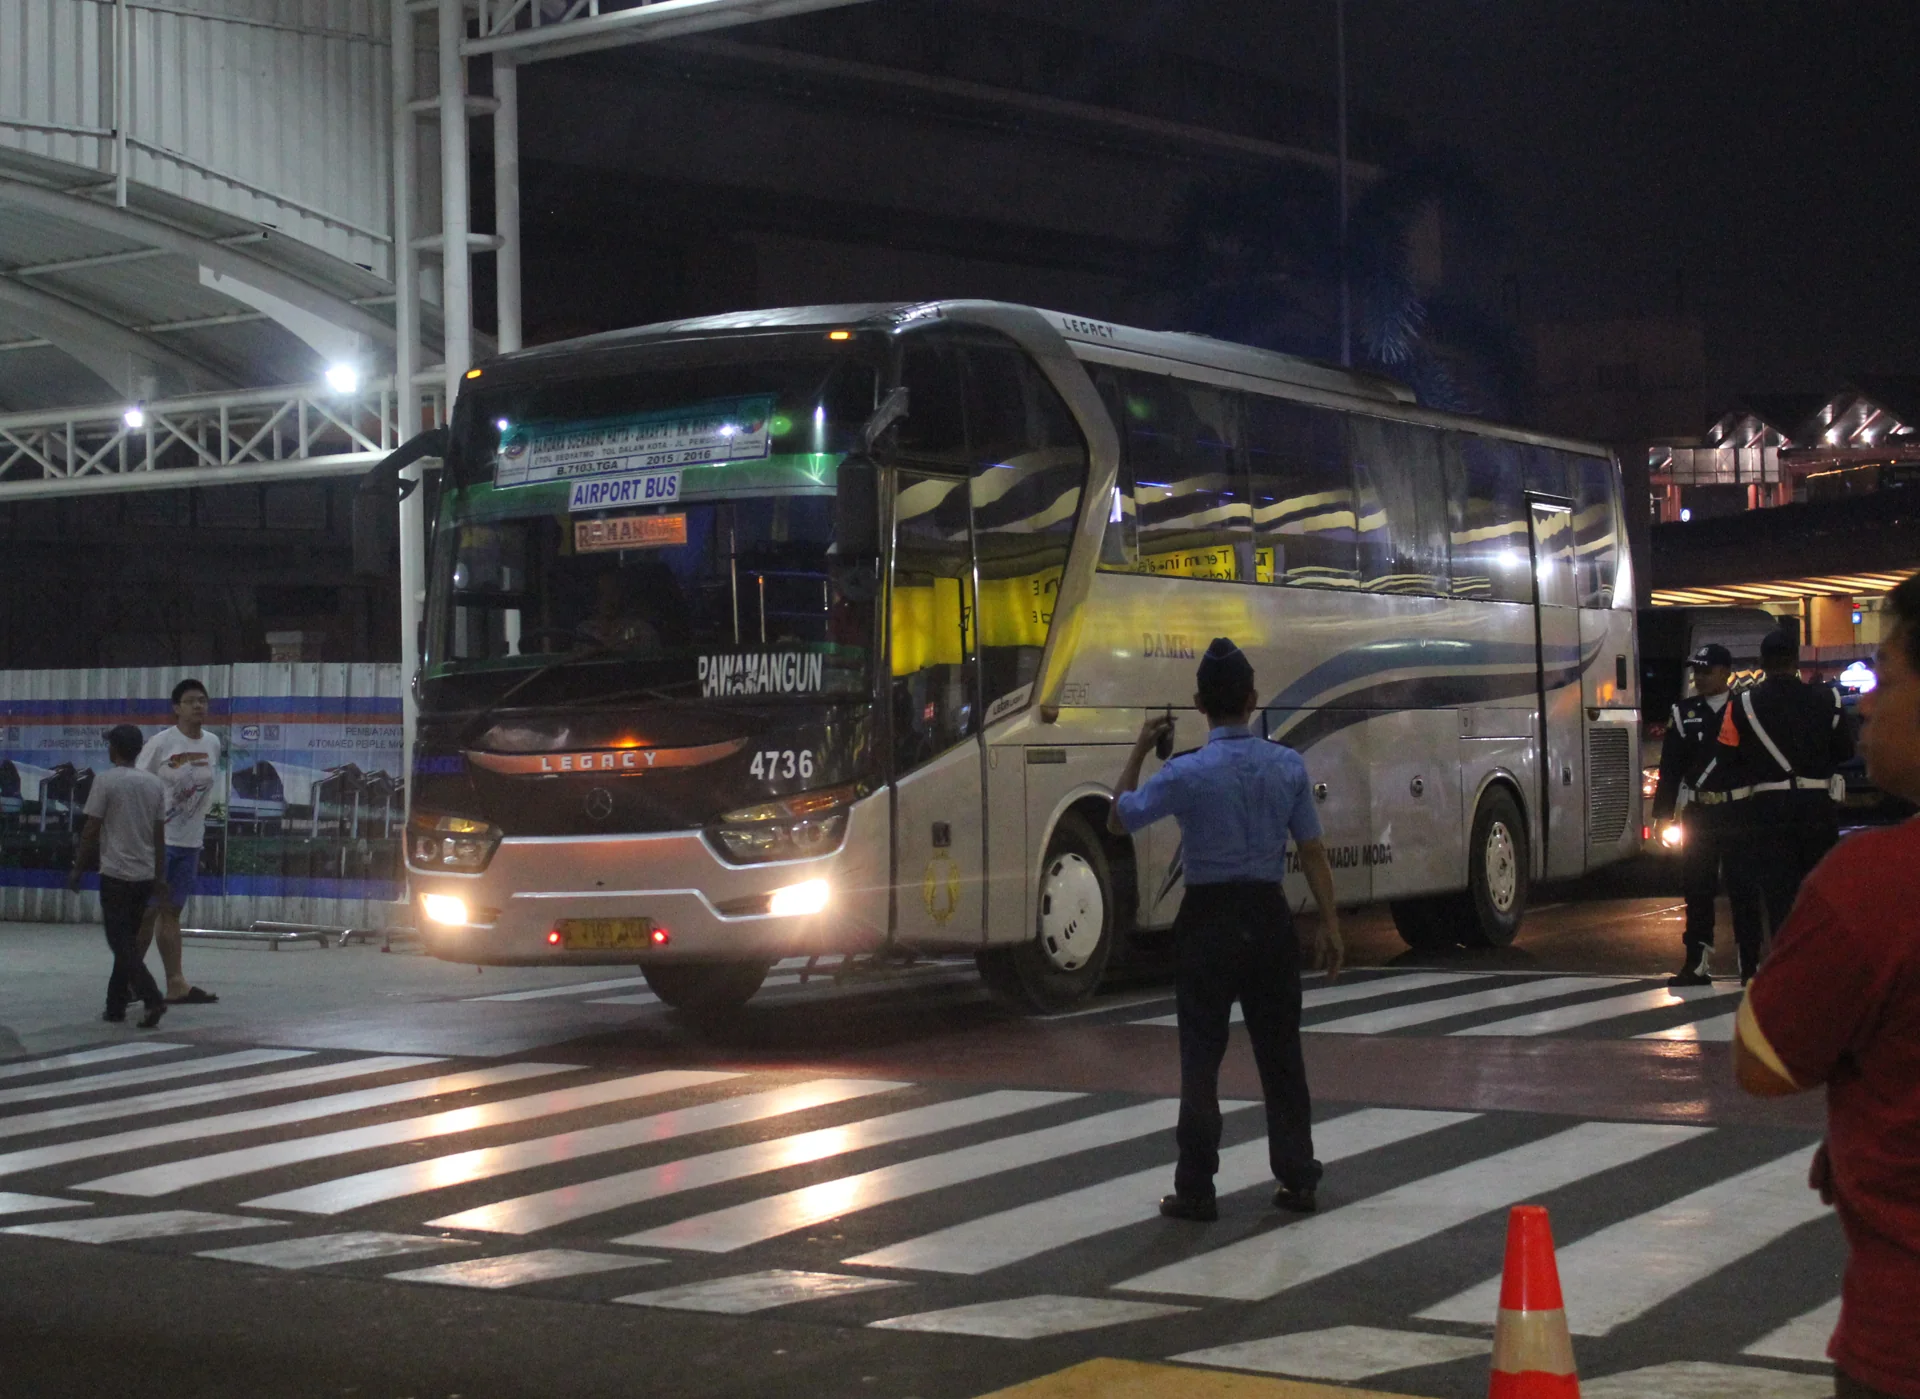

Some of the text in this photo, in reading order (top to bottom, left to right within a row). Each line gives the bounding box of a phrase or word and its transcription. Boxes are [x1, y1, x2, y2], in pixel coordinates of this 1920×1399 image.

[1062, 317, 1114, 340] LEGACY
[646, 441, 667, 451] KOTA
[557, 460, 618, 476] B.7103.TGA
[646, 454, 674, 465] 2015
[683, 450, 711, 461] 2016
[573, 475, 677, 505] AIRPORT BUS
[1142, 633, 1195, 660] DAMRI
[541, 752, 657, 771] LEGACY
[750, 749, 814, 780] 4736
